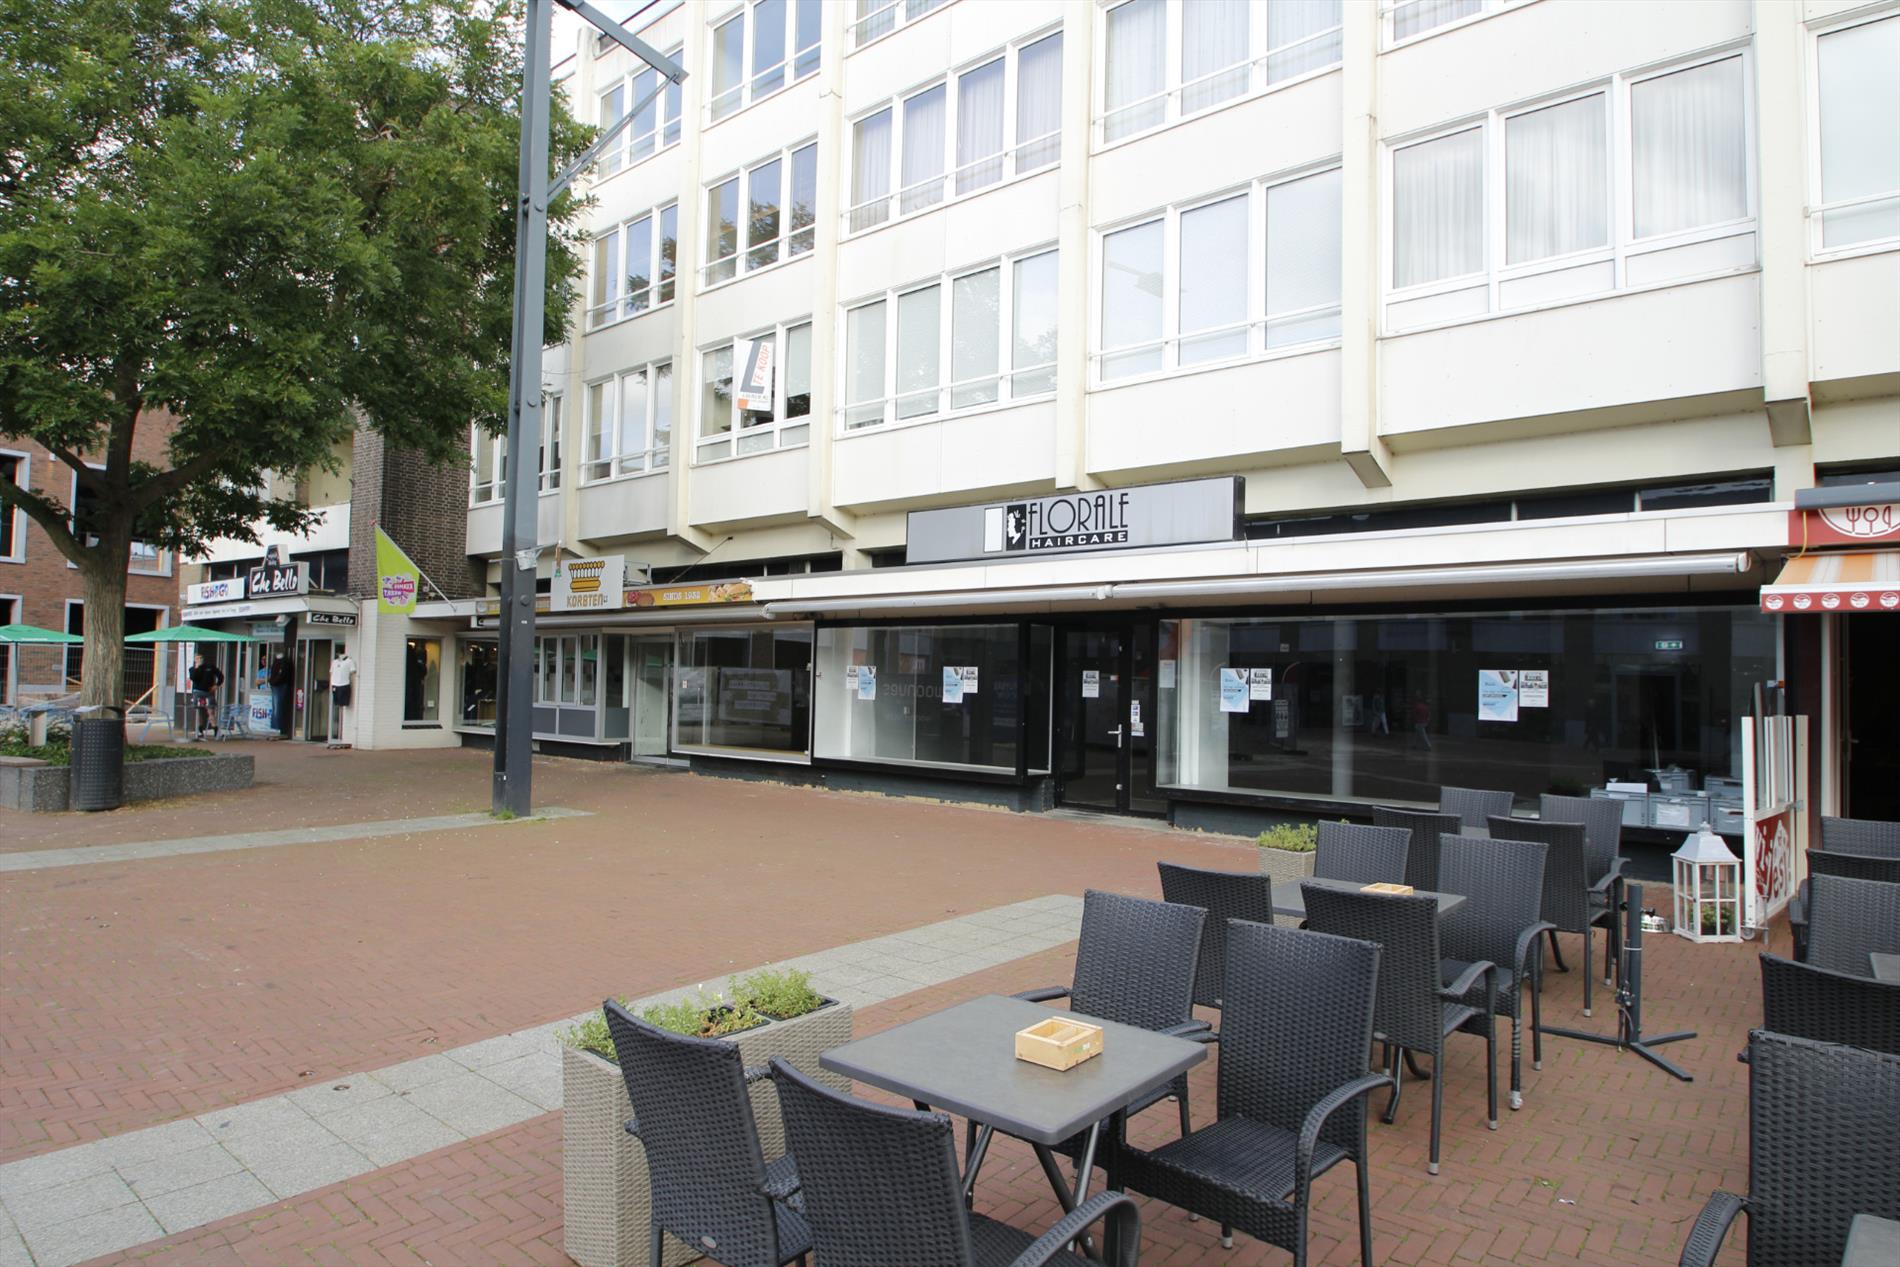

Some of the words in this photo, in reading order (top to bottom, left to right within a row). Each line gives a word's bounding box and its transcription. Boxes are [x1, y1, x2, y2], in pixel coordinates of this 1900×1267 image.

[1028, 492, 1129, 536] FLORALE
[1031, 532, 1127, 548] HAIRCARE
[252, 572, 271, 592] Che
[272, 568, 298, 591] Bello
[312, 614, 330, 623] Che
